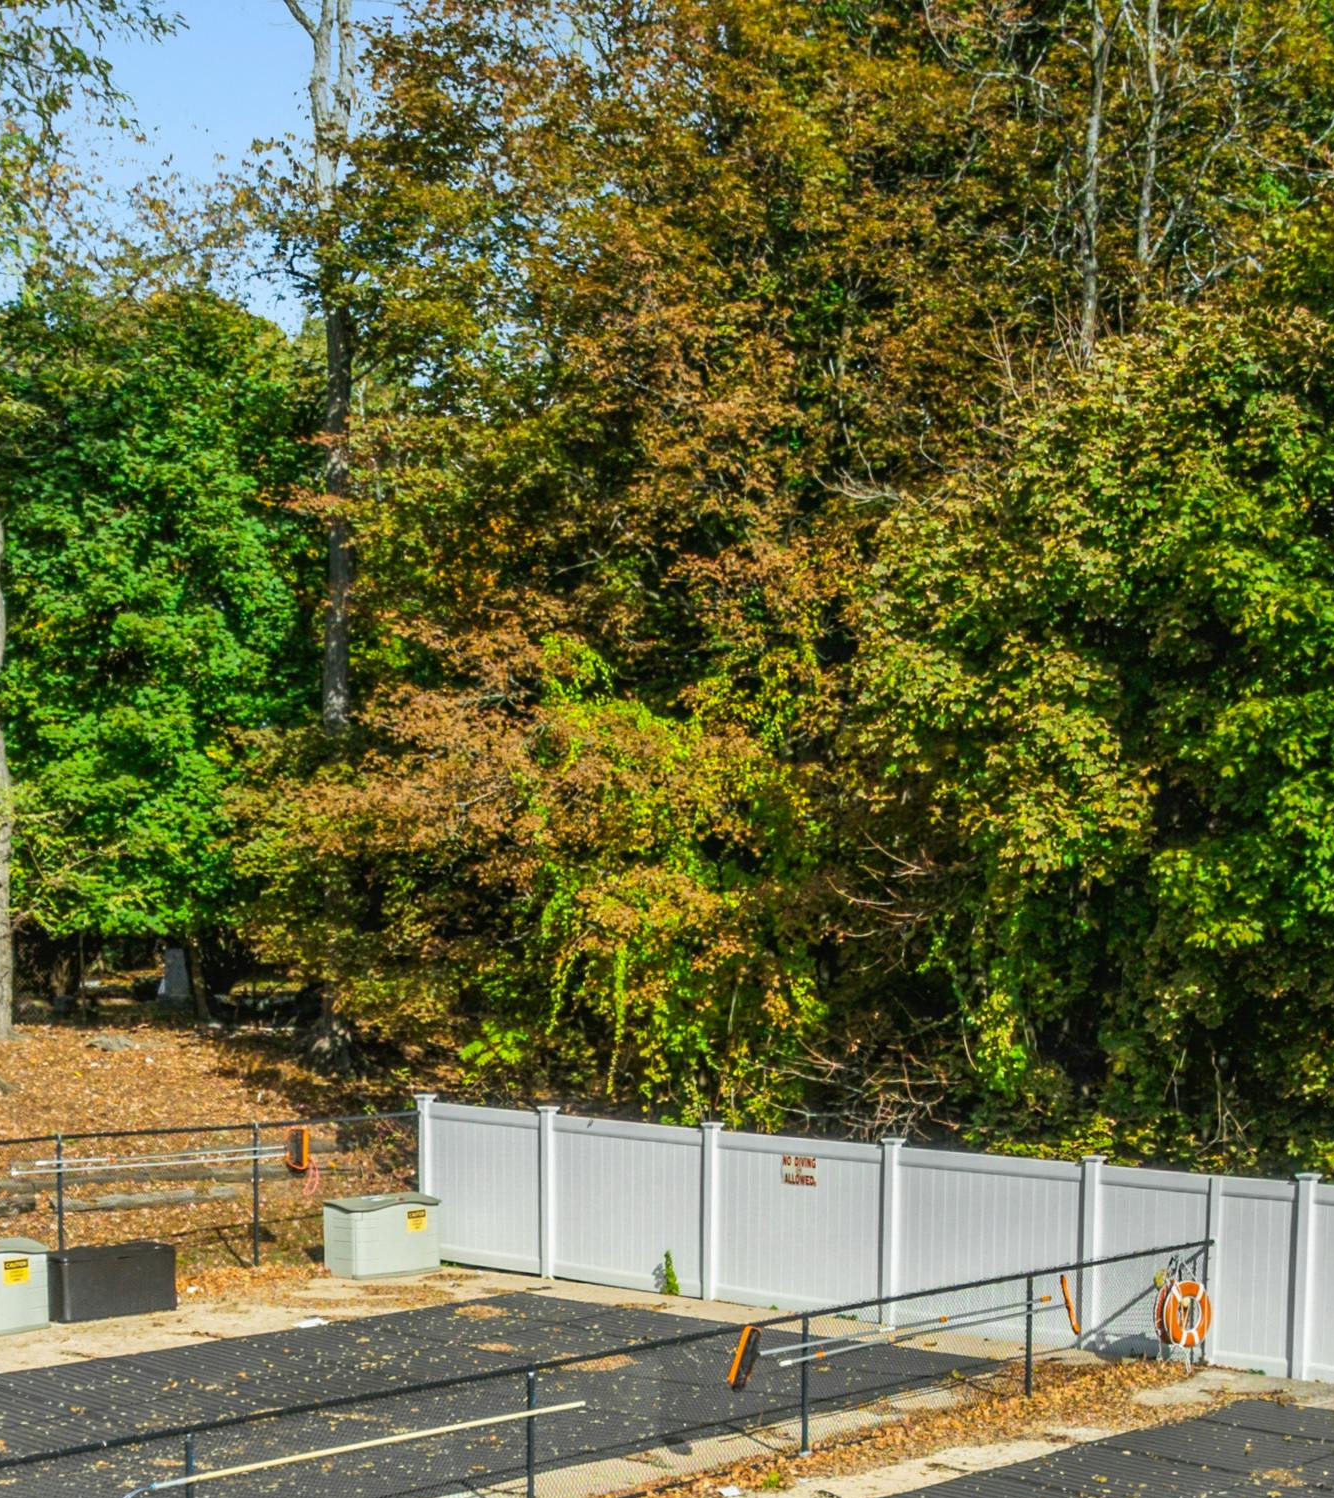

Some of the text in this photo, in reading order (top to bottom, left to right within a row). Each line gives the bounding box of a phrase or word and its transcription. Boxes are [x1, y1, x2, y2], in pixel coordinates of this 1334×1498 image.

[782, 1154, 817, 1169] NO DIVING
[784, 1173, 815, 1186] ALLOWED
